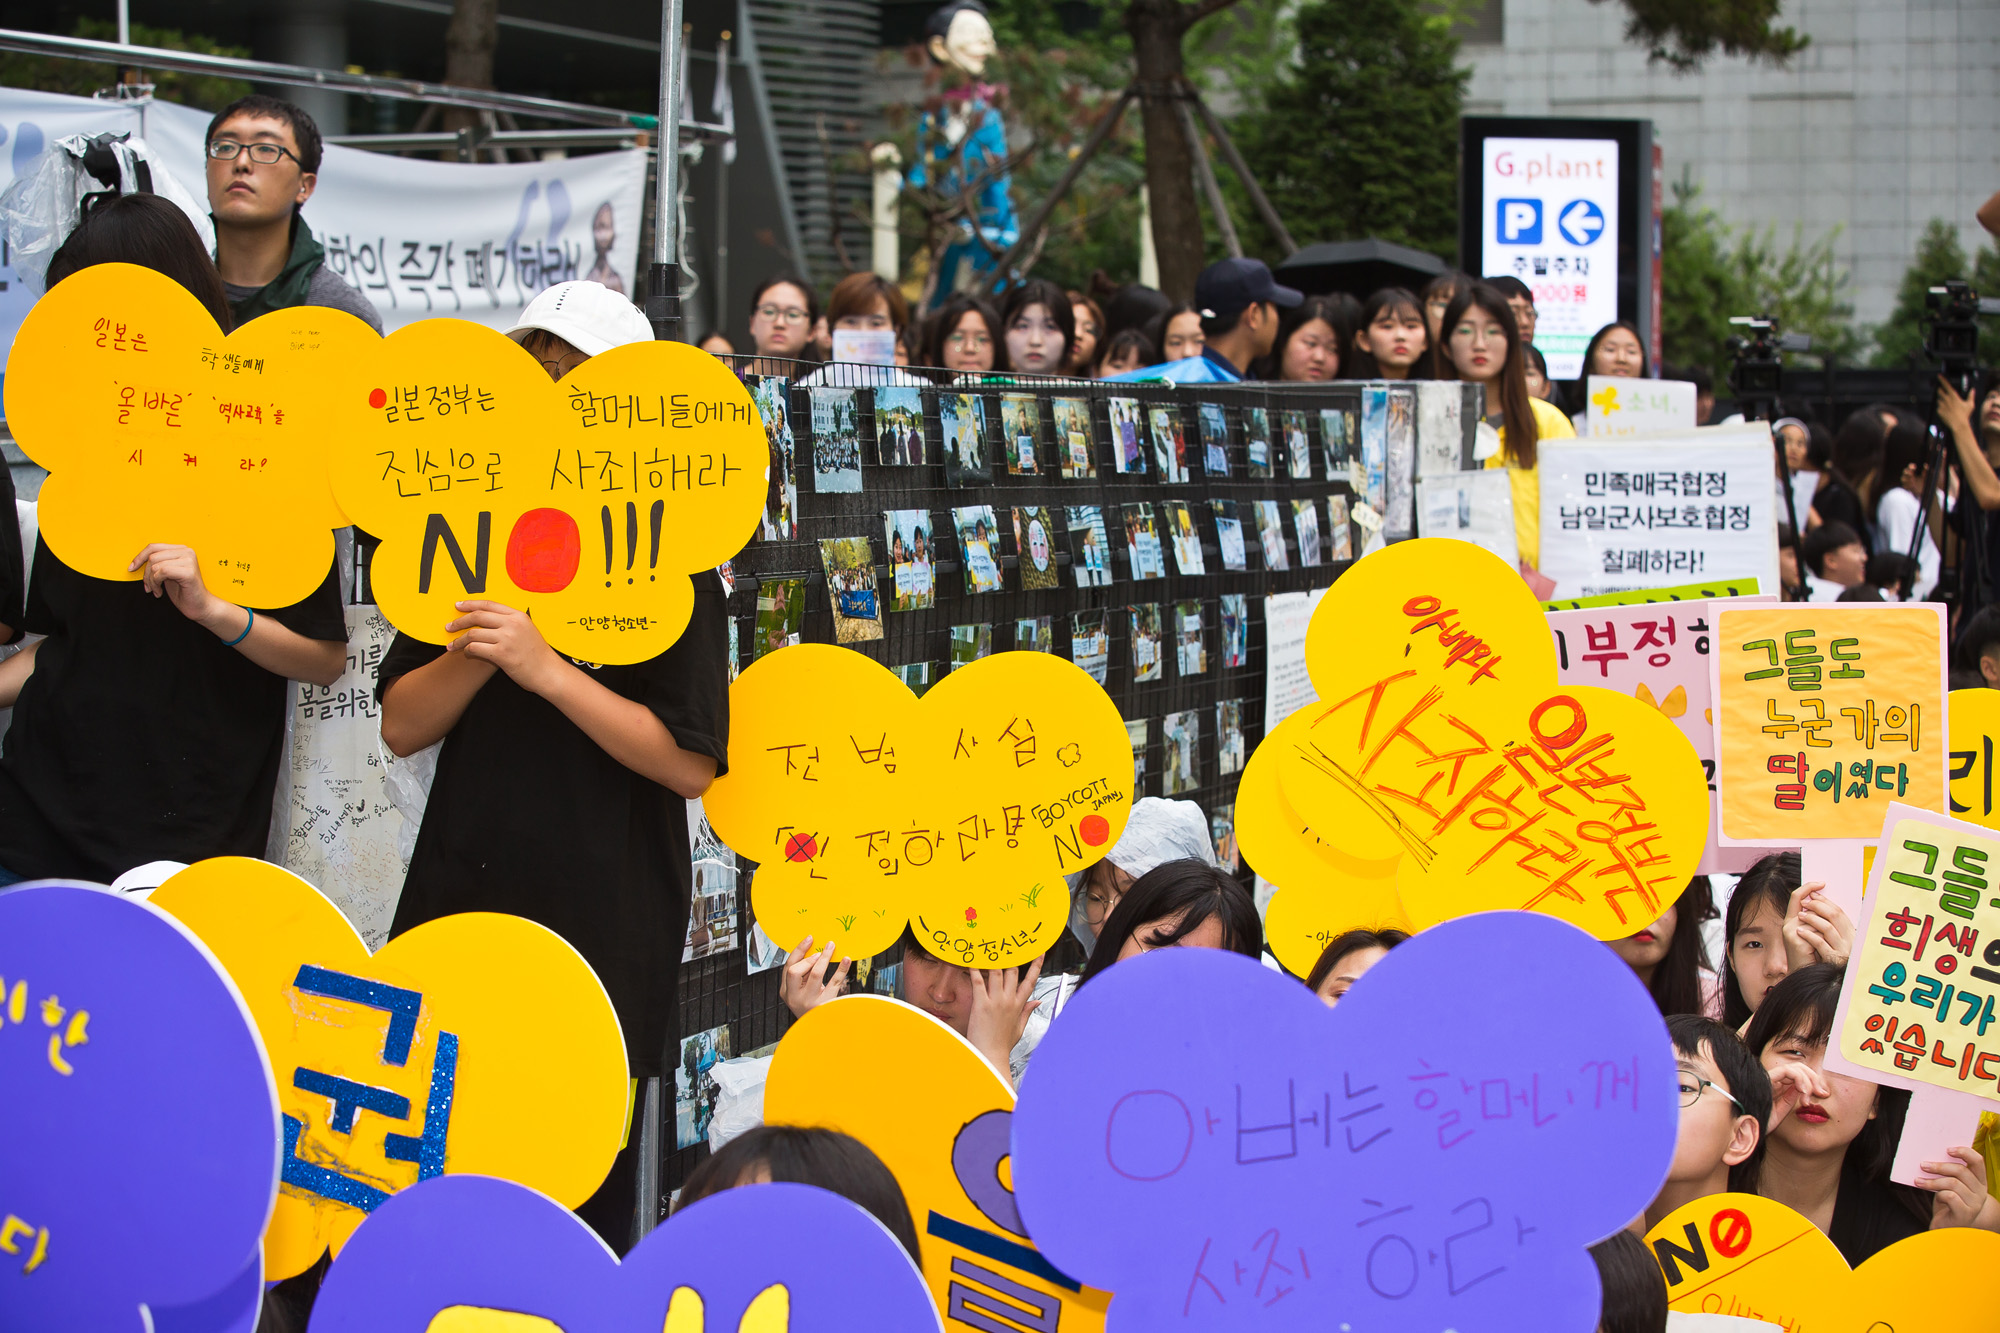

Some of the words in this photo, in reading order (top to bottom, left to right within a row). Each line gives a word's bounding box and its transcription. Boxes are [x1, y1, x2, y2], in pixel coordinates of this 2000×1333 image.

[1495, 151, 1604, 184] G.plant
[1504, 202, 1537, 240] P
[400, 240, 461, 311] 즉각
[1530, 284, 1586, 303] 000원
[93, 317, 149, 353] 일본은
[368, 384, 496, 424] 일본정부는
[568, 384, 752, 429] 할머니들에게
[376, 448, 504, 497] 진심으로
[549, 447, 742, 494] 사죄해라
[1585, 472, 1727, 497] 민족매국협정
[1602, 549, 1705, 574] 철폐하라!
[1402, 594, 1502, 686] 아베와
[1742, 629, 1866, 692] 그들도
[1762, 698, 1921, 752] 누군가의
[1888, 839, 2000, 921] 그들
[1868, 961, 1996, 1037] 우리가
[1105, 1070, 1394, 1182] 아베는
[1652, 1207, 1753, 1288] NO
